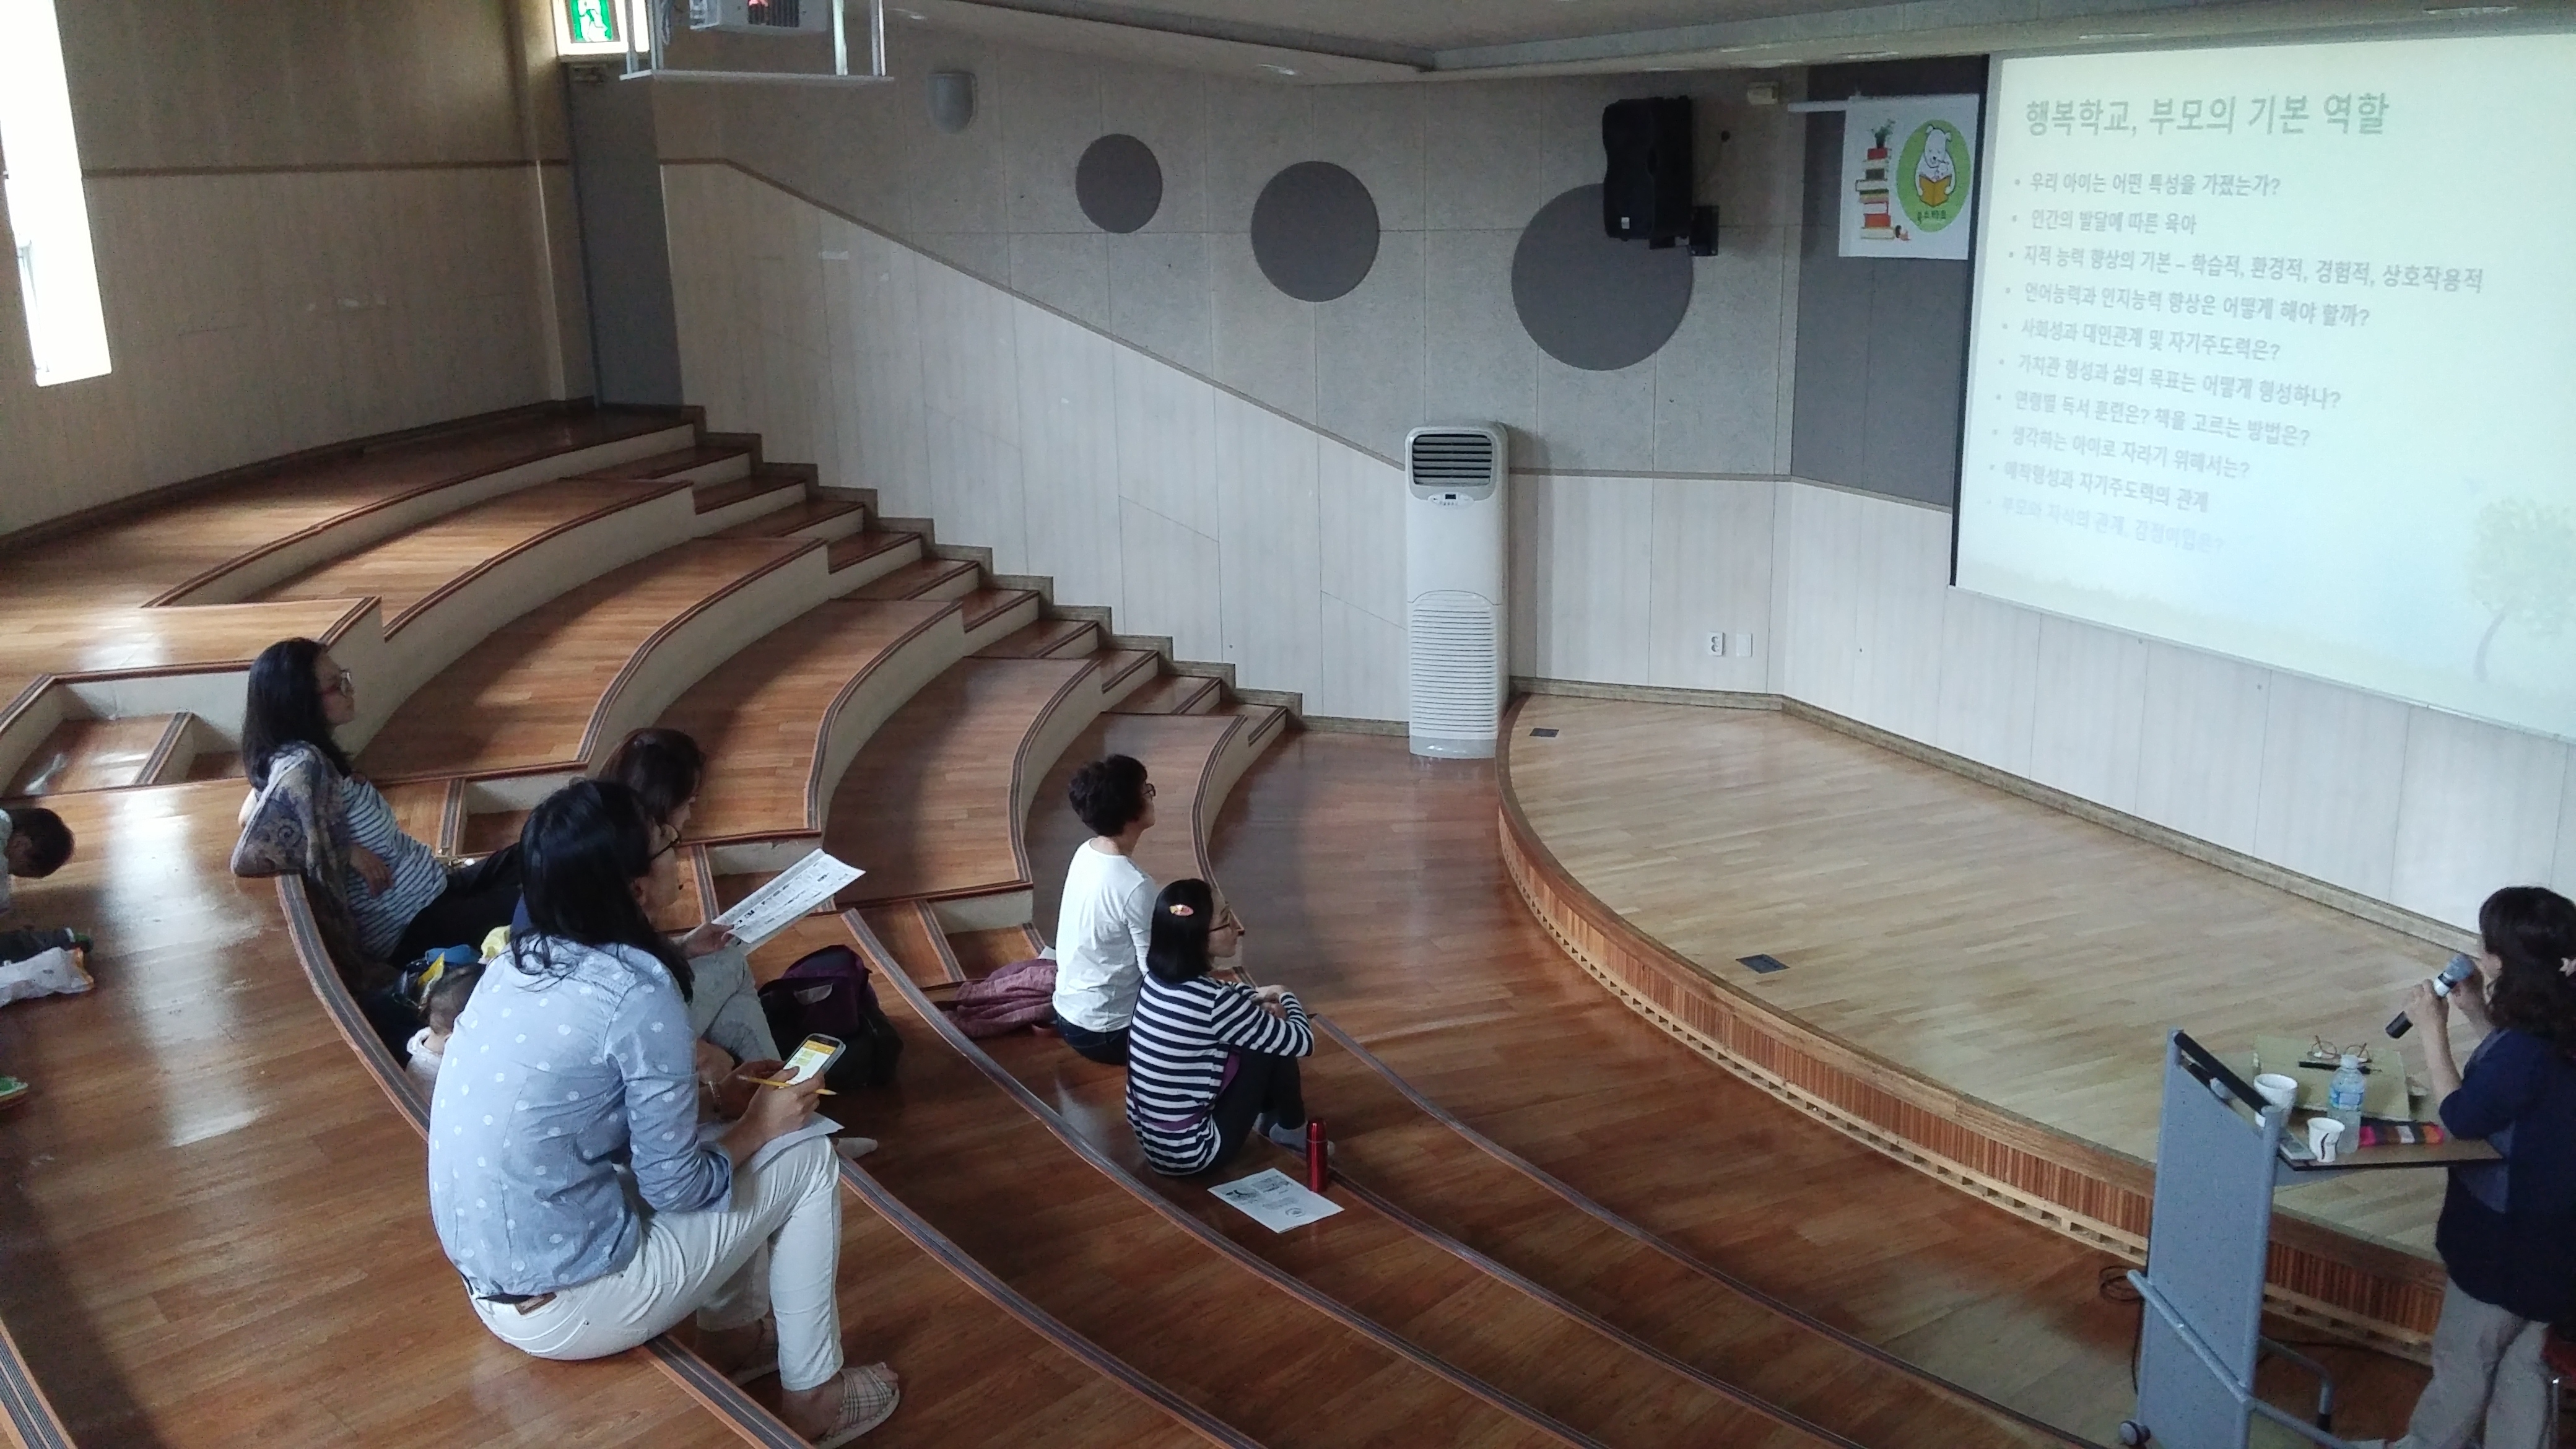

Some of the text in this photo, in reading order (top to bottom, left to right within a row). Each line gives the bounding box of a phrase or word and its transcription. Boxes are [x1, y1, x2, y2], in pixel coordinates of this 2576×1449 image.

[2026, 92, 2389, 137] 행복학교, 부모의 기본 역할
[2030, 172, 2281, 196] 우리 아이는 어떤 특성을 가졌는가?
[2032, 209, 2196, 235] 인간의 발달에 따른 육아
[2024, 245, 2052, 266] 지적
[2057, 248, 2084, 268] 능력
[2091, 248, 2134, 271] 향상의
[2141, 251, 2171, 273] 기본
[2192, 253, 2245, 279] 학습적,
[2250, 256, 2308, 282] 환경적,
[2315, 259, 2375, 288] 경험적,
[2383, 264, 2483, 294] 상호작용적
[2025, 281, 2370, 327] 언어능력과 인지능력 향상은 어떻게 해야 할까?
[2021, 318, 2281, 361] 사회성과 대인관계 및 자기주도력은?
[2019, 354, 2342, 410] 가치관 형성과 삶의 목표는 어떻게 형성하나?
[2062, 396, 2089, 418] 독서
[2095, 400, 2149, 425] 훈련은?
[2154, 407, 2185, 430] 책을
[2192, 413, 2240, 439] 고르는
[2248, 419, 2310, 446] 방법은?
[2014, 425, 2250, 479] 생각하는 아이로 자라기 위해서는?
[2079, 471, 2170, 507] 자기주도력의
[2177, 488, 2209, 513] 관계
